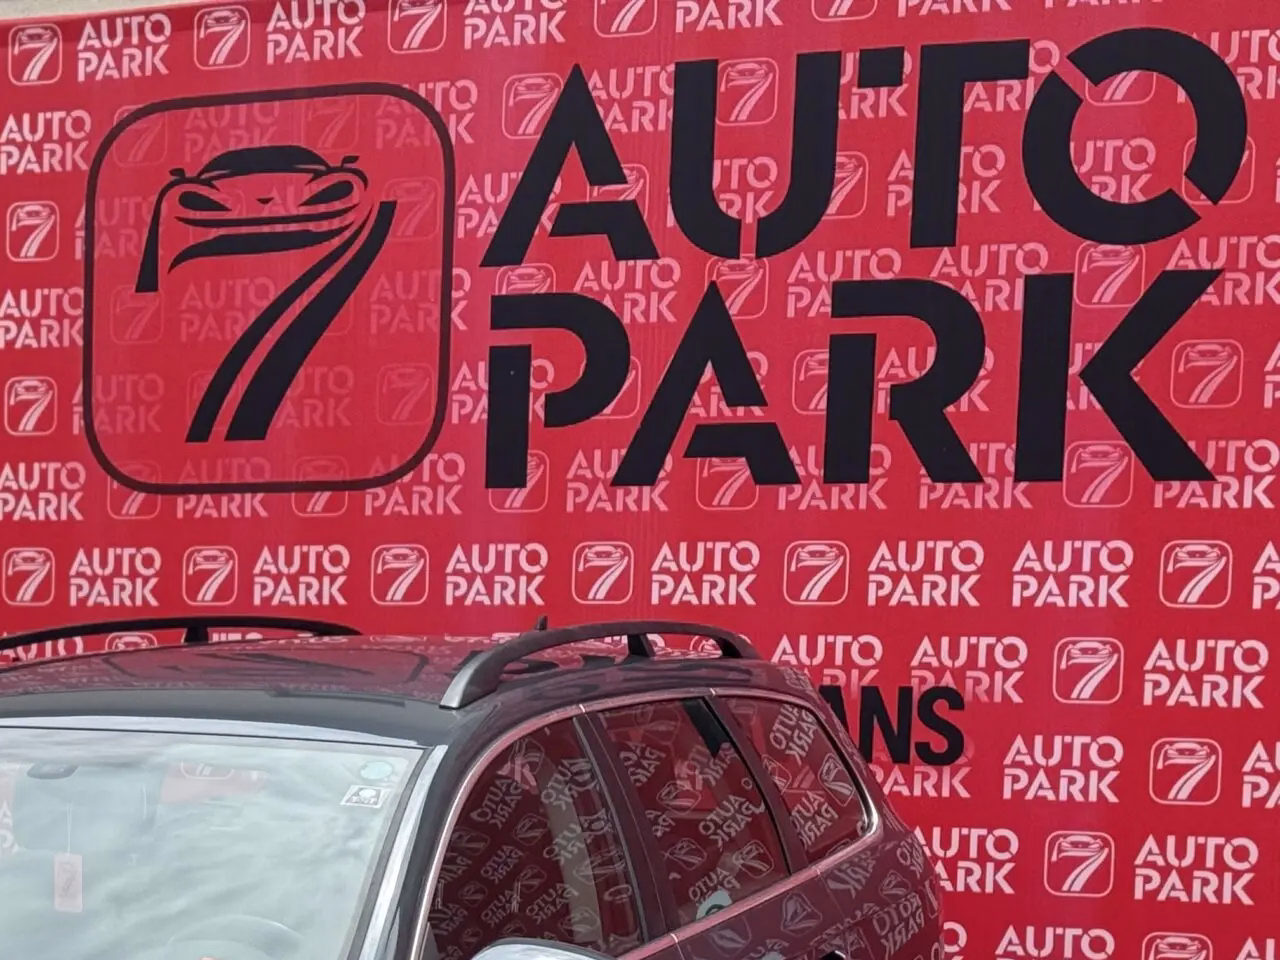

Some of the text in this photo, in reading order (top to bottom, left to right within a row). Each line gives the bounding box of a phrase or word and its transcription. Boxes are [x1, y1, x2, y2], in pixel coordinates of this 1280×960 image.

[77, 13, 171, 50] AUTO
[267, 0, 365, 32] AUTO
[465, 11, 566, 49] PARK
[676, 0, 782, 32] PARK
[267, 26, 363, 64] PARK
[78, 44, 168, 82] PARK
[0, 110, 91, 143] AUTO
[0, 141, 88, 175] PARK
[479, 27, 1247, 267] AUTO
[485, 268, 1225, 488] PARK
[366, 485, 460, 515] PARK
[567, 481, 668, 511] PARK
[779, 479, 886, 509] PARK
[70, 547, 161, 576] AUTO
[253, 544, 350, 574] AUTO
[446, 543, 548, 573] AUTO
[651, 541, 760, 572] AUTO
[868, 540, 984, 573] AUTO
[1012, 540, 1134, 574] AUTO
[70, 578, 158, 606] PARK
[254, 576, 346, 605] PARK
[446, 575, 544, 605] PARK
[651, 574, 756, 605] PARK
[868, 574, 980, 606] PARK
[1012, 574, 1129, 607] PARK
[771, 635, 882, 666] AUTO
[911, 636, 1028, 670] AUTO
[1143, 639, 1269, 673] AUTO
[1144, 673, 1264, 708] PARK
[1004, 735, 1124, 769] AUTO
[1003, 768, 1119, 802] PARK
[1135, 835, 1258, 870] AUTO
[1135, 868, 1254, 905] PARK
[995, 926, 1114, 960] AUTO
